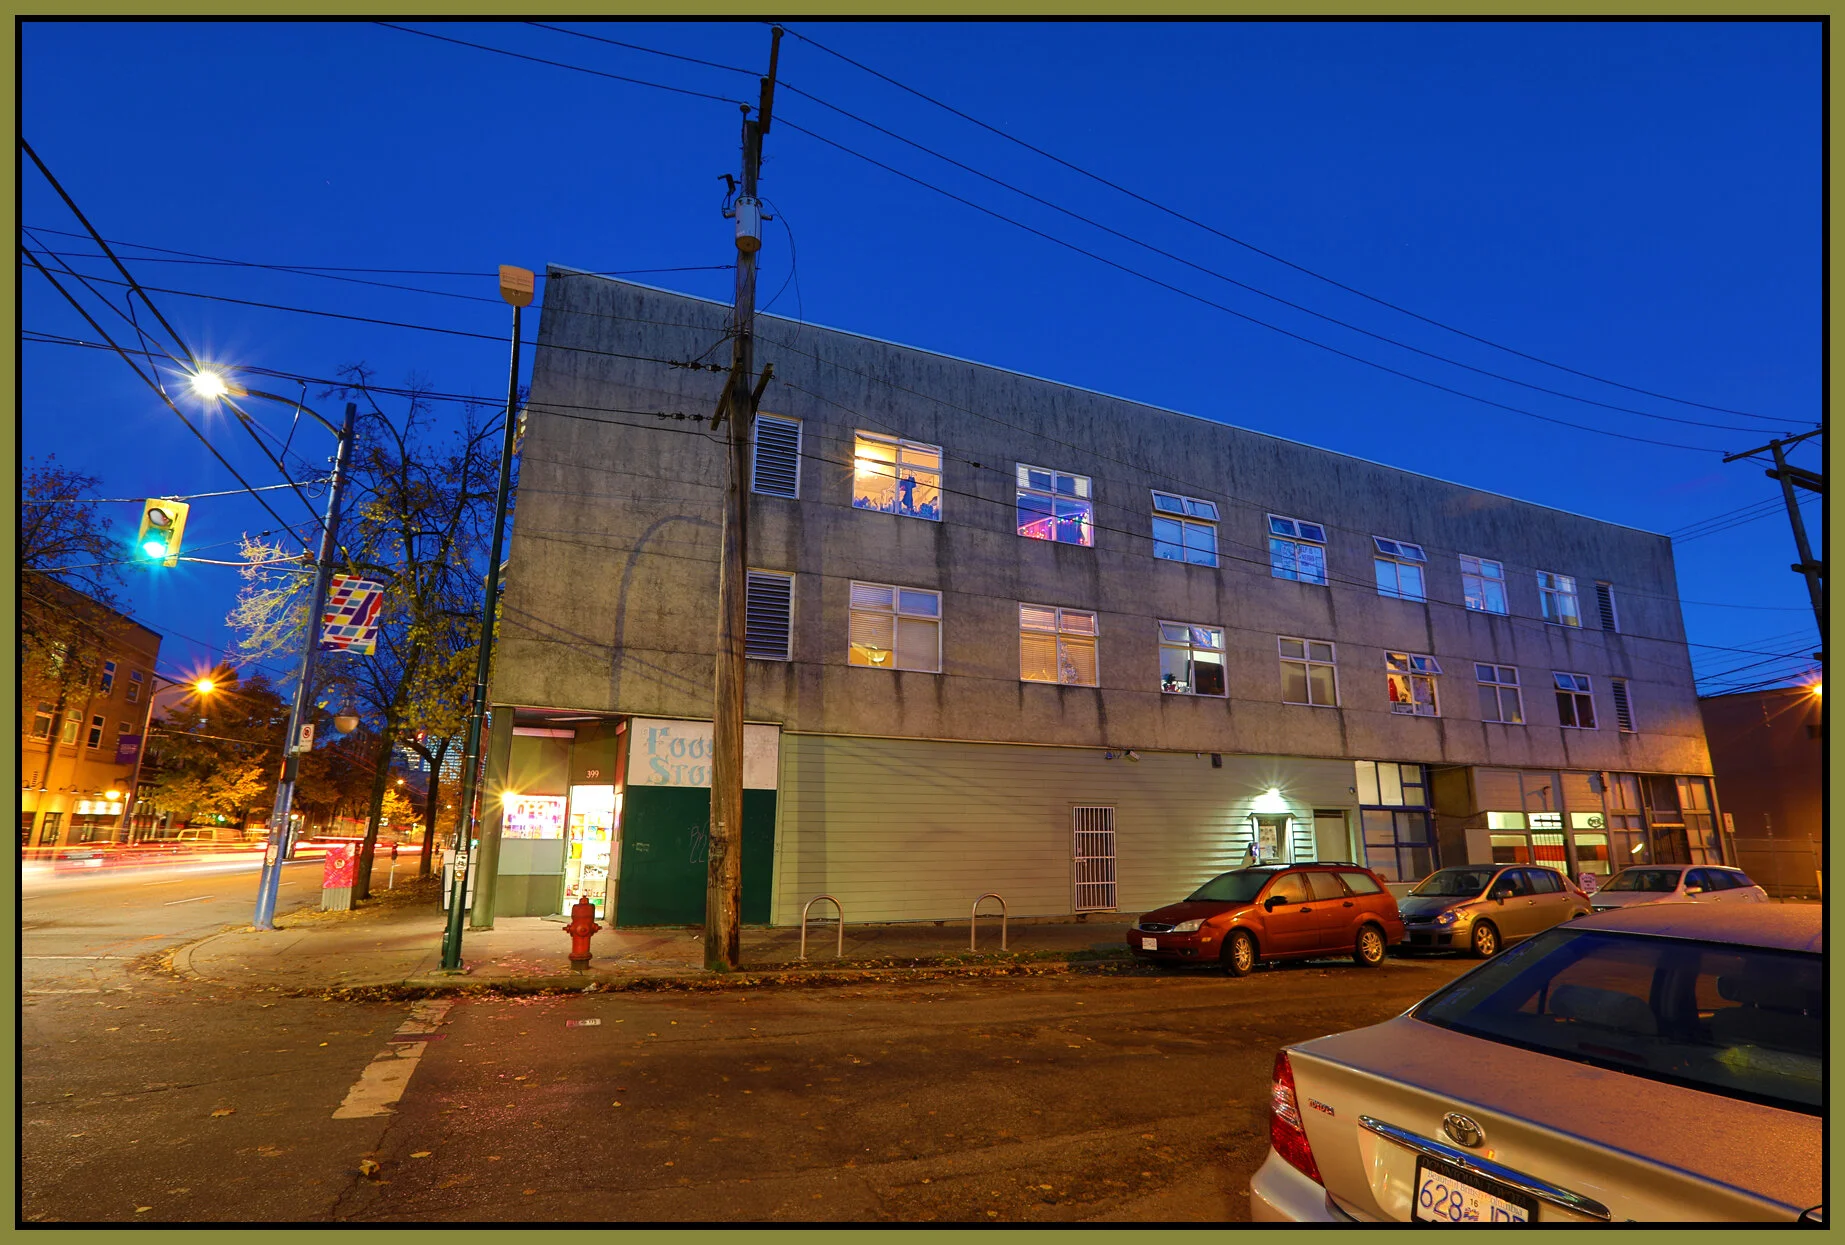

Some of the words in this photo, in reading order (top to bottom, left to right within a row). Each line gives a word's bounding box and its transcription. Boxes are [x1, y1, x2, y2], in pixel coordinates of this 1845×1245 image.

[586, 769, 600, 779] 399
[1420, 1179, 1463, 1222] 628
[1469, 1198, 1479, 1208] 16
